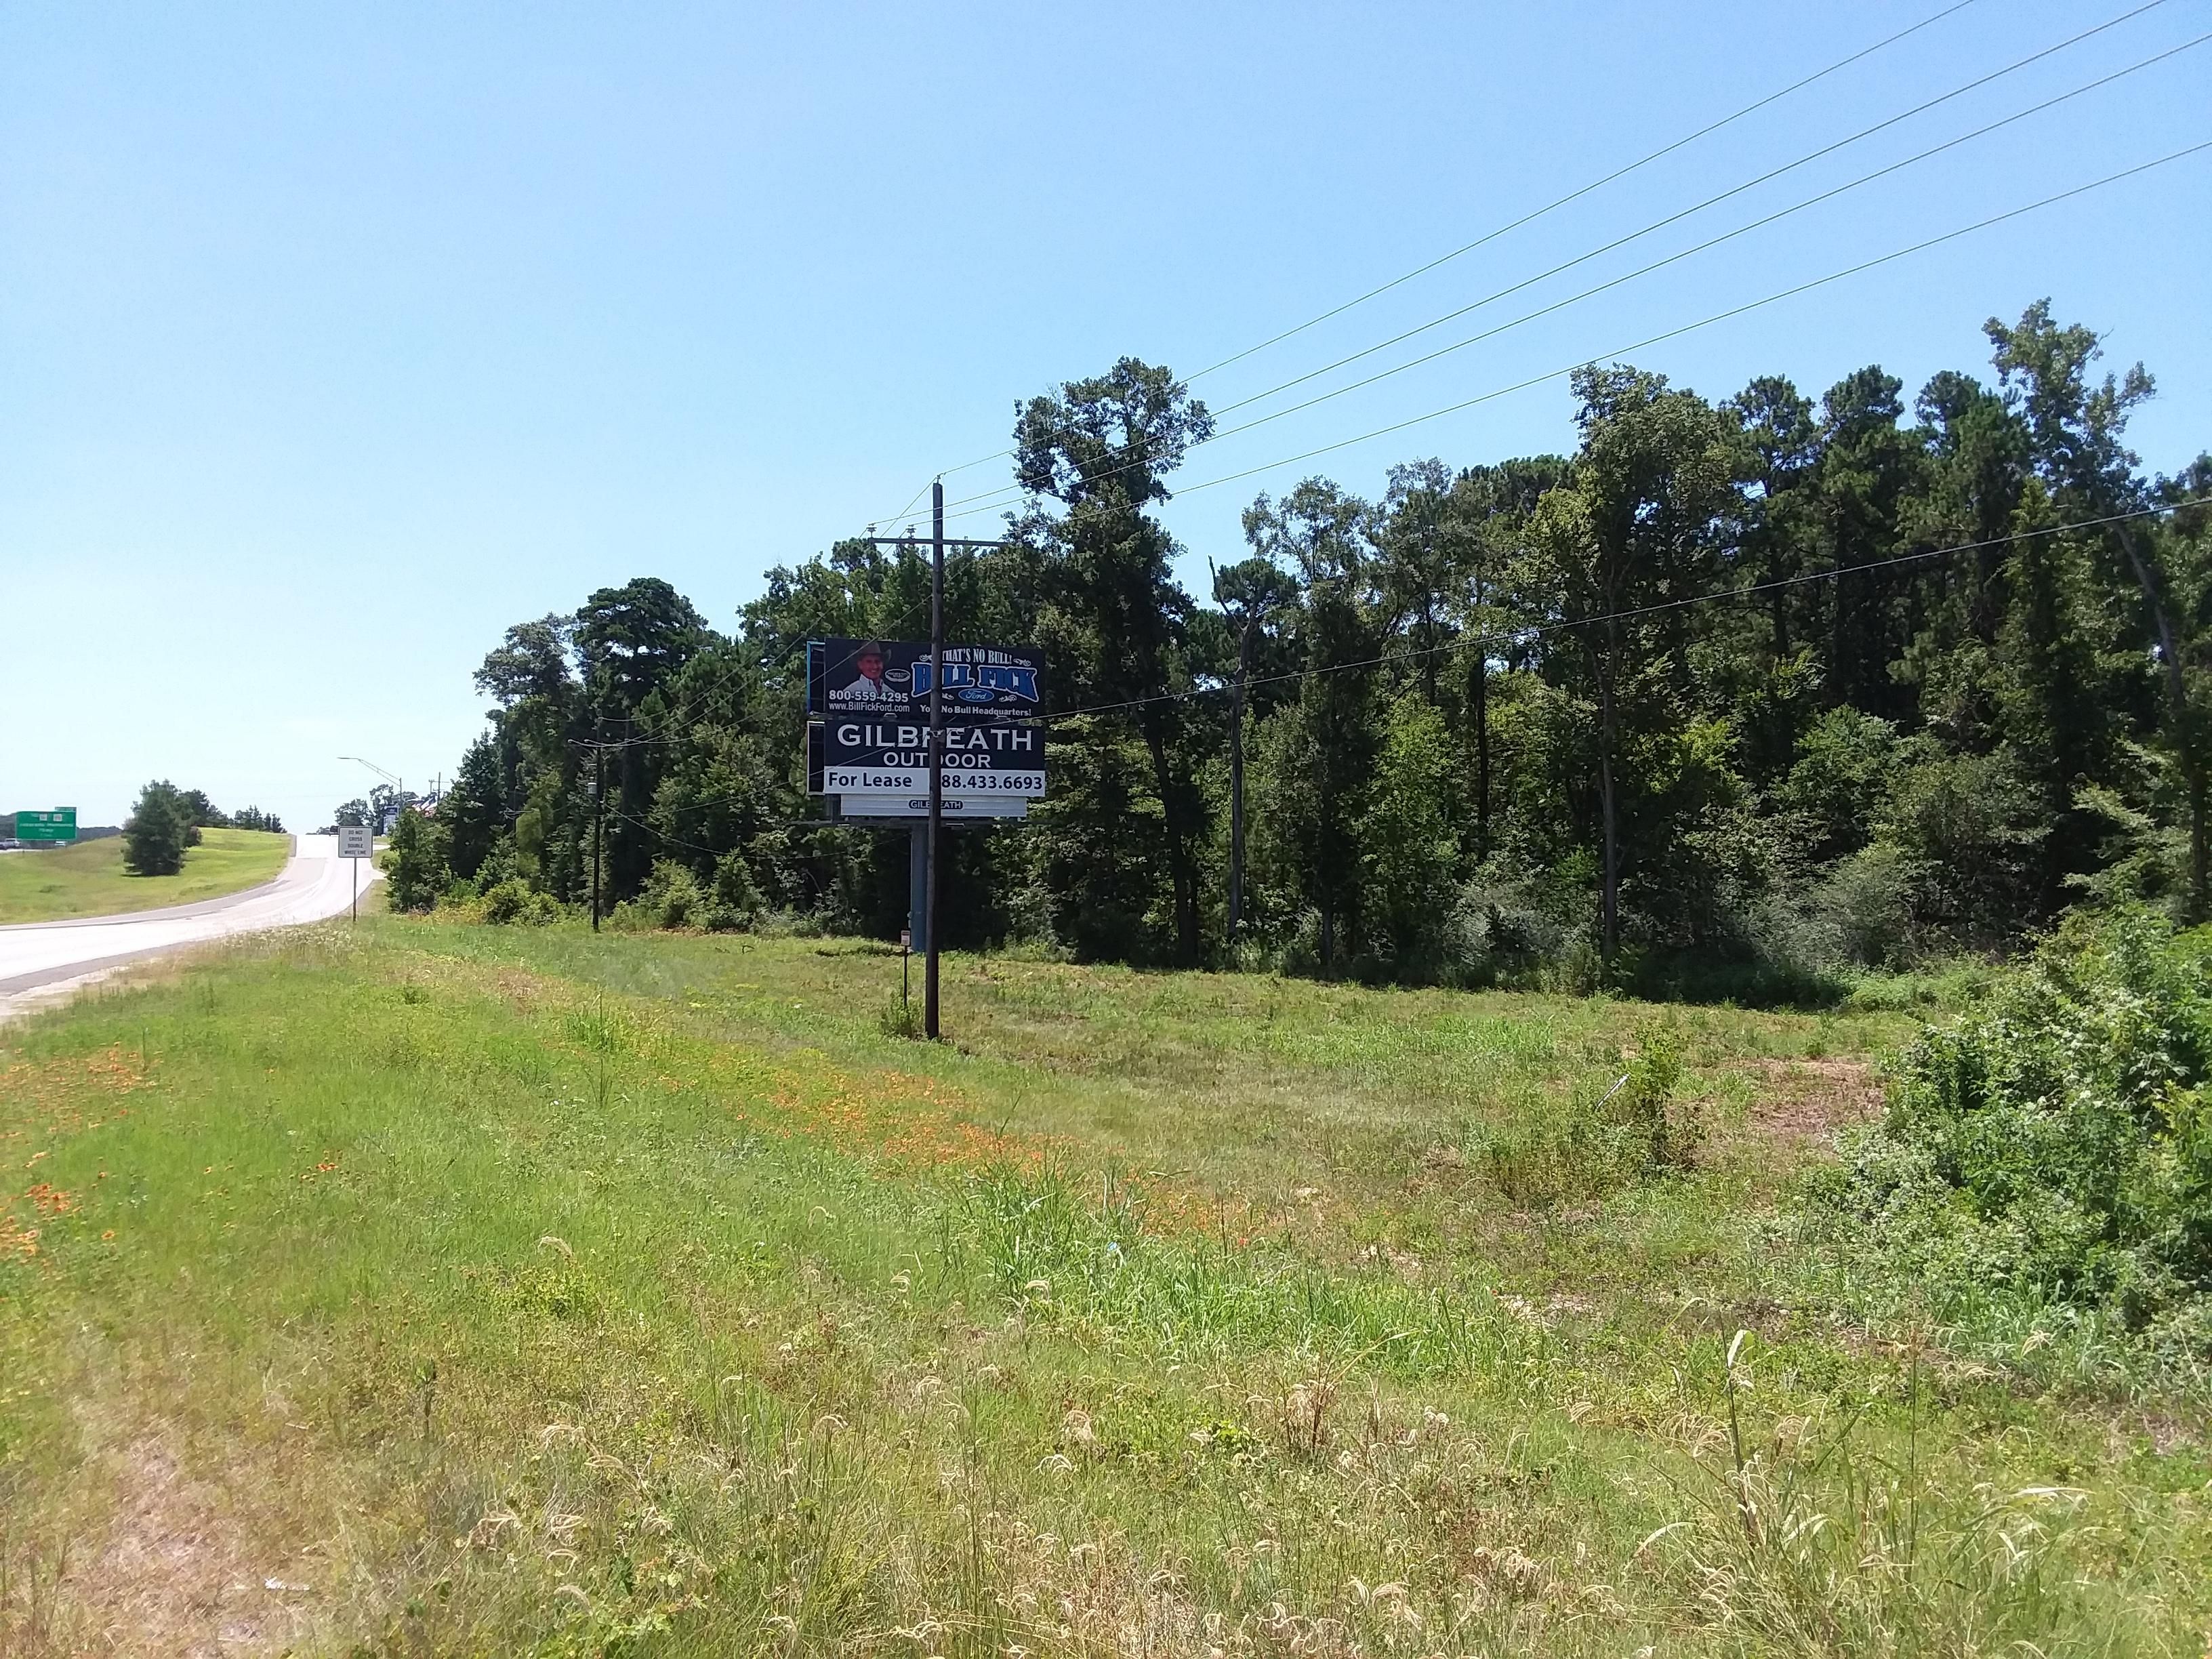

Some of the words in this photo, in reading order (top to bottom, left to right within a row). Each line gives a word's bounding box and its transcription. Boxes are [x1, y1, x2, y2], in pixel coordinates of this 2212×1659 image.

[972, 648, 985, 663] NO
[988, 650, 1012, 665] BULL!
[912, 662, 975, 698] BLL
[977, 665, 1039, 702] FICK
[829, 689, 909, 703] 800-559-4295
[829, 701, 910, 713] www.BillFickFord.com
[920, 704, 931, 712] Yo
[941, 705, 953, 714] No
[954, 705, 970, 714] Bull
[972, 707, 1031, 716] Headquarters!
[883, 752, 991, 769] OUTOOR
[829, 772, 857, 787] For
[863, 772, 912, 787] Lease
[941, 774, 1043, 790] 88.433.6693
[910, 800, 961, 808] GILBEATH
